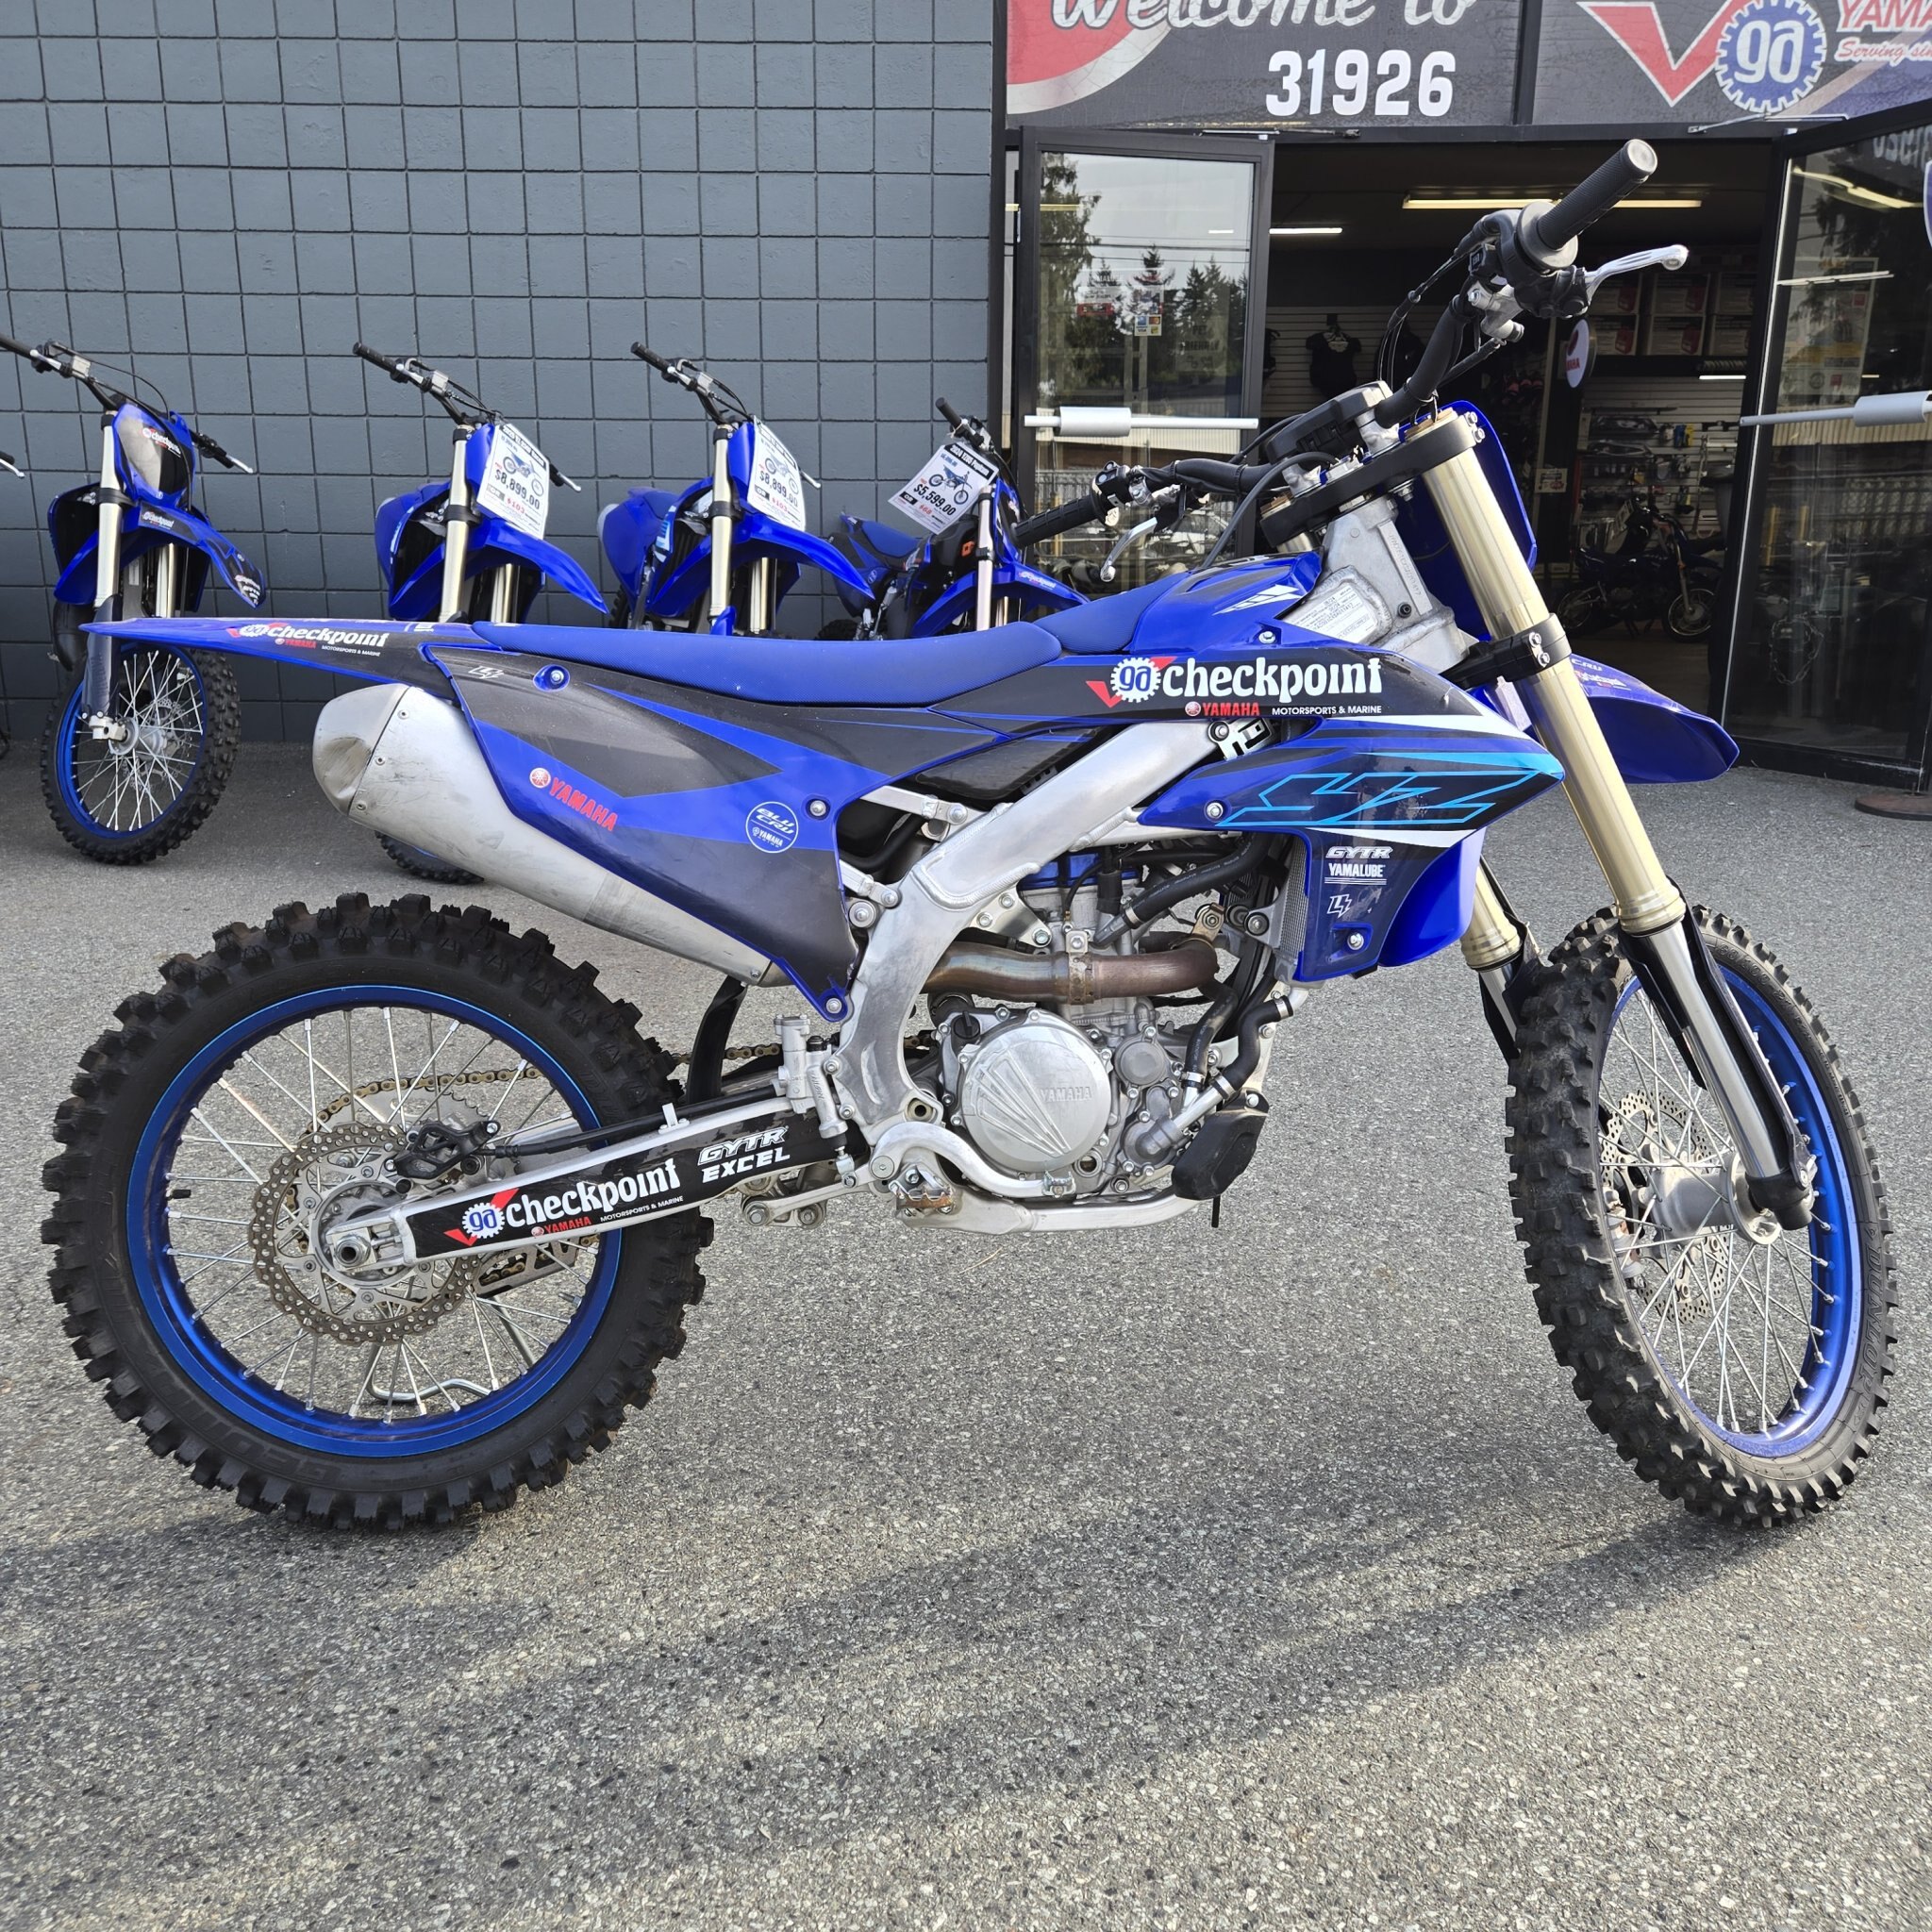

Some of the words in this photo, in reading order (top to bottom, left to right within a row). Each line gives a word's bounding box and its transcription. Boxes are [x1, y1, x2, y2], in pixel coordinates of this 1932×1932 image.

[1838, 40, 1904, 63] Serving
[1266, 48, 1457, 116] 31926
[494, 469, 541, 510] $8,899.00
[760, 470, 799, 508] $8,899.00
[914, 483, 956, 516] $5,599.00
[267, 625, 390, 648] checkpoint
[321, 645, 357, 654] MOTORSPORTS
[1572, 658, 1603, 672] CRU
[1162, 657, 1383, 704] checkpoint
[1202, 702, 1260, 717] YAMAHA
[1272, 706, 1337, 716] MOTORSPORTS
[1339, 706, 1346, 714] &
[1347, 705, 1382, 714] MARINE
[549, 777, 619, 831] YAMAHA
[756, 808, 794, 827] BLU
[756, 814, 794, 834] CRU
[759, 829, 783, 847] YAMAHA
[1324, 846, 1393, 859] GYTR
[1328, 863, 1385, 877] YAMALUBE
[1040, 1086, 1091, 1103] YAMAHA
[697, 1126, 790, 1166] GYTR
[701, 1146, 791, 1184] EXCEL
[506, 1158, 681, 1228] checkpoint
[600, 1205, 651, 1224] MOTORSPORTS
[658, 1195, 684, 1208] MARINE
[544, 1216, 591, 1235] YAMAHA
[1859, 1245, 1884, 1393] DUNLOP
